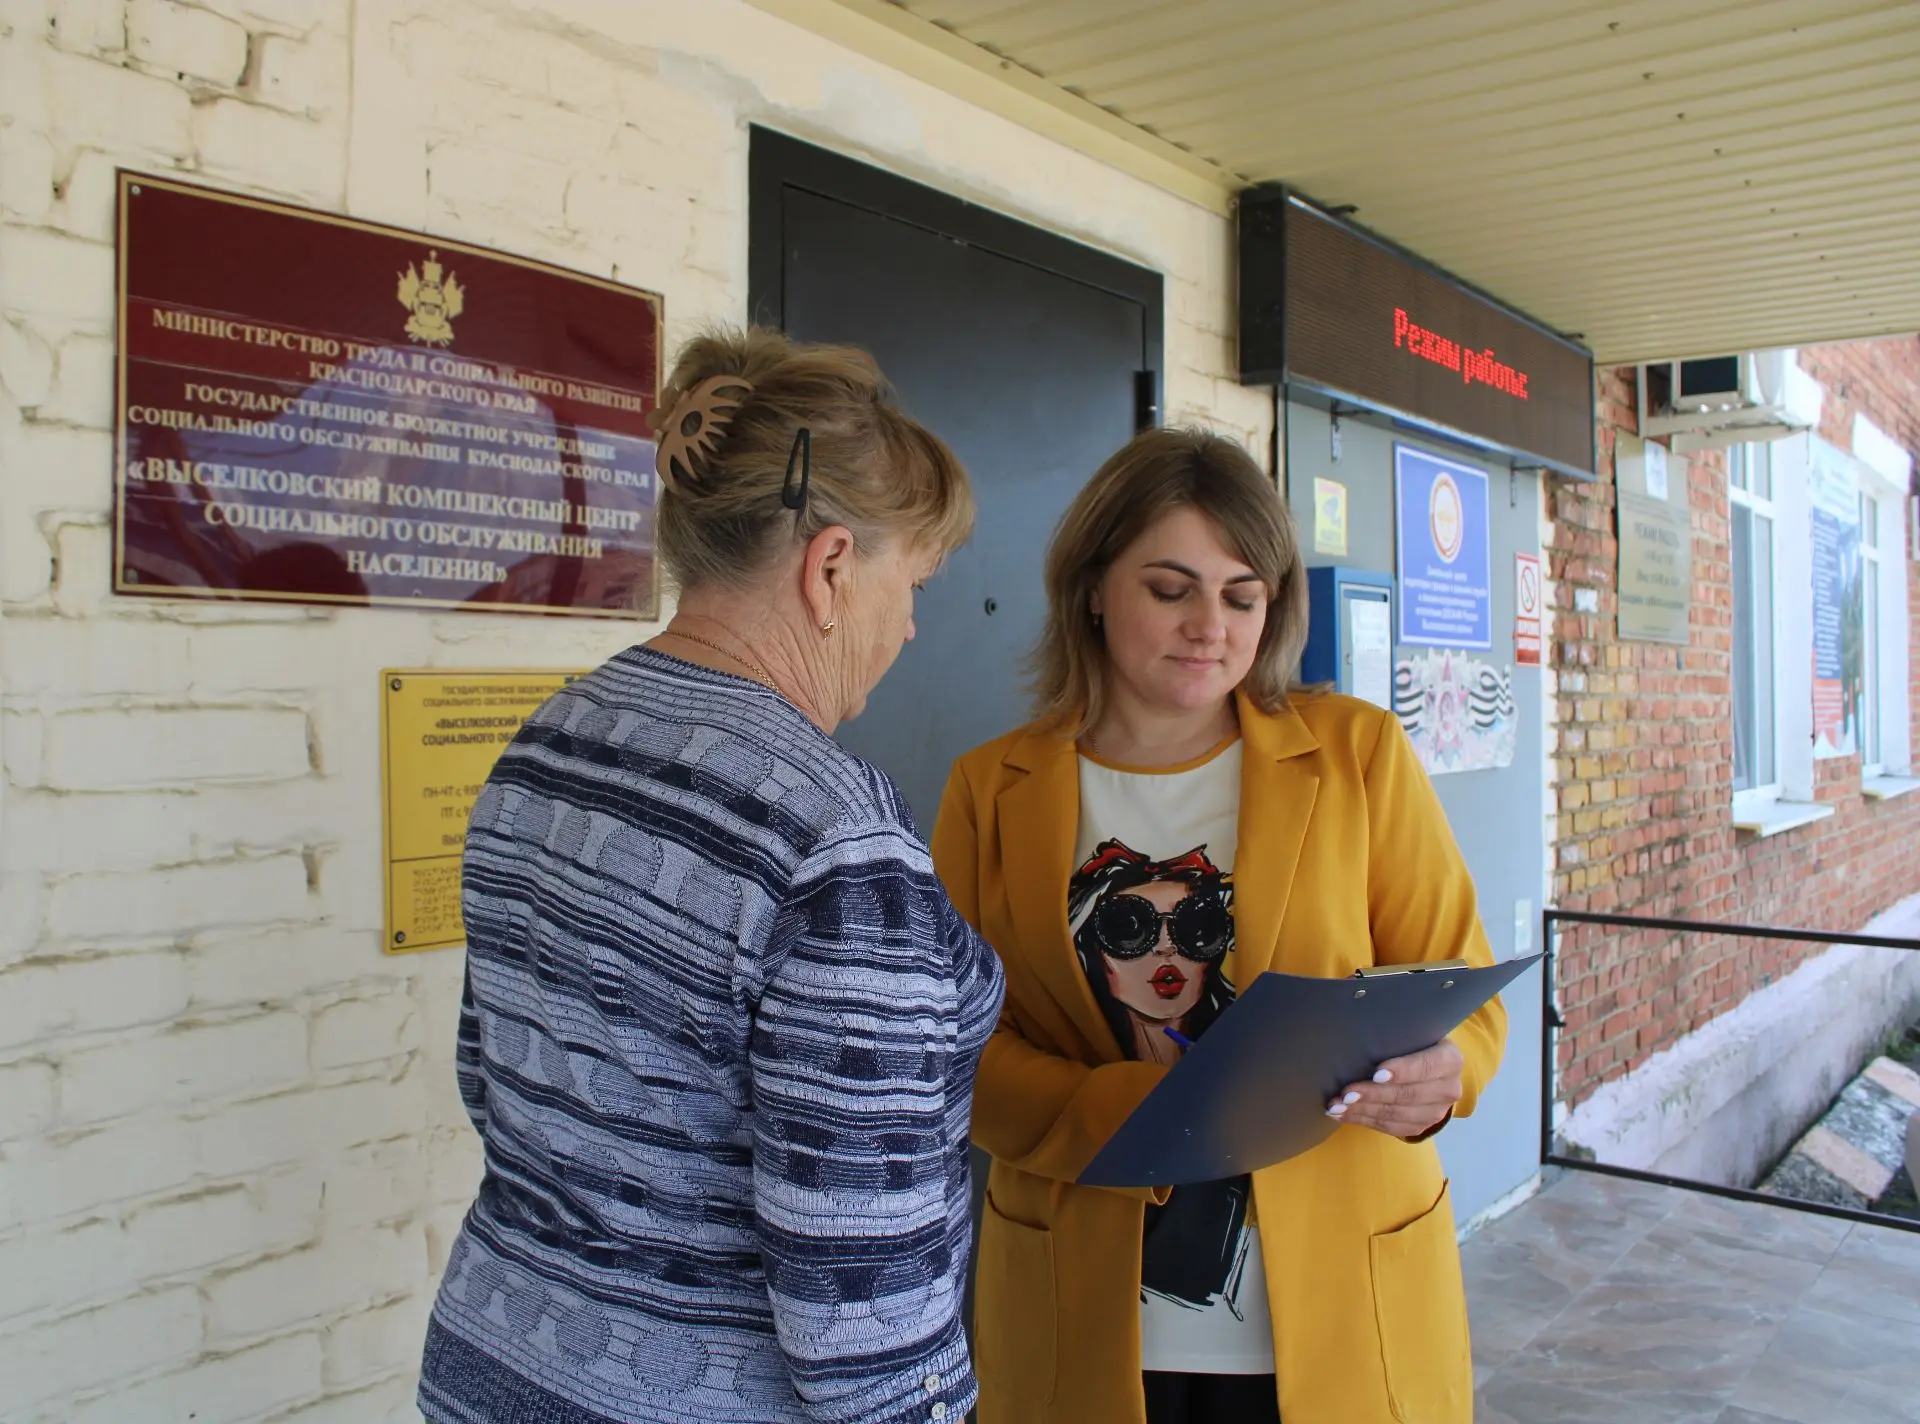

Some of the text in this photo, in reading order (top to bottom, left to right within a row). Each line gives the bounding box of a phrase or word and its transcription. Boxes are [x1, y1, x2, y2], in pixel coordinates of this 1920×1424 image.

[152, 308, 642, 413] МИНИСТЕРСТВО ТРУДА И СОЦИАЛЬНОГО РАЗВИТИЯ
[1394, 307, 1461, 373] Режим
[309, 360, 537, 415] КРАСНОДАРСКОГО КРАЯ
[128, 405, 650, 489] СОЦИАЛЬНОГО ОБСЛУЖИВАНИЯ КРАСНОДАРСКОГО КРАЯ
[184, 383, 616, 460] ГОСУДАРСТВЕННОЕ БЮДЖЕТНОЕ УЧРЕЖДЕНИЕ
[128, 457, 642, 532] «ВЫСЕЛКОВСКИЙ КОМПЛЕКСНЫЙ ЦЕНТР
[204, 502, 603, 560] СОЦИАЛЬНОГО ОБСЛУЖИВАНИЯ
[346, 549, 508, 583] НАСЕЛЕНИЯ»
[422, 732, 495, 746] СОЦИАЛЬНОГО
